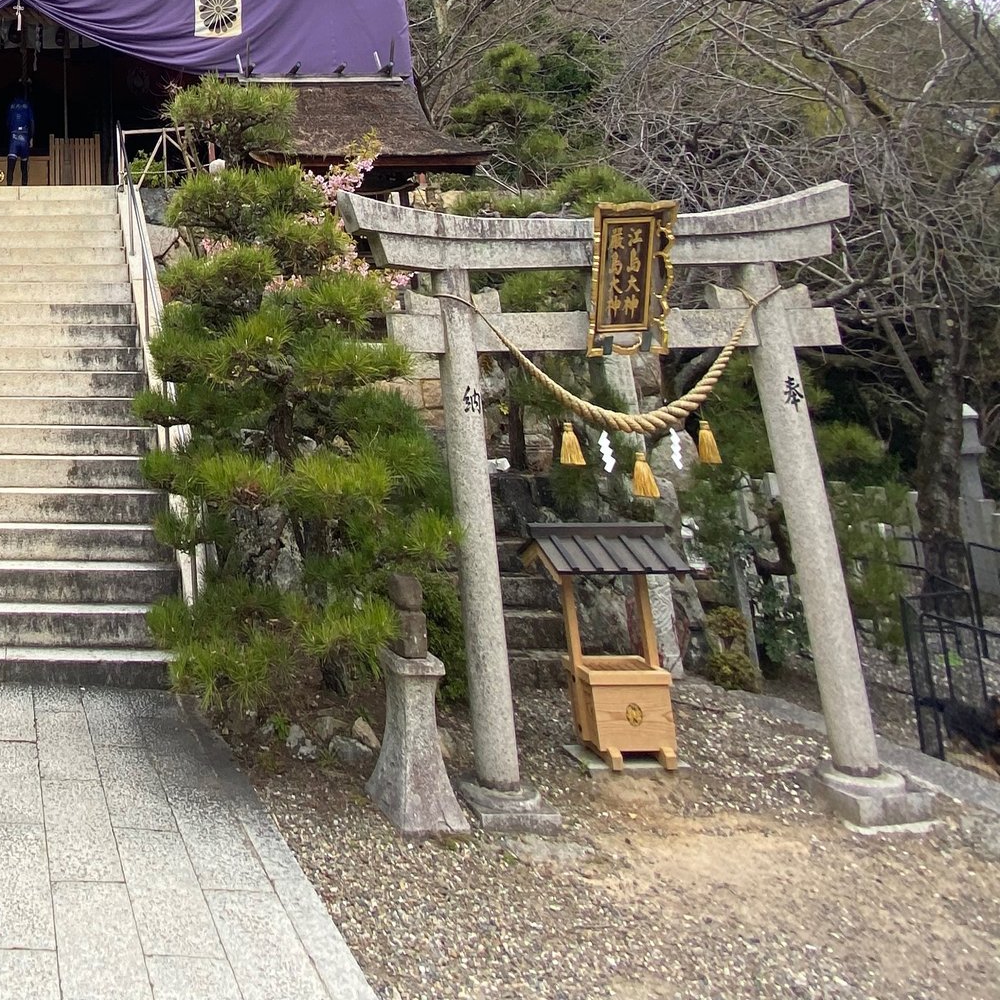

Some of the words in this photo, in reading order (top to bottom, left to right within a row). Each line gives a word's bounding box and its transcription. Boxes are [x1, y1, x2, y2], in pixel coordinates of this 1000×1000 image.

[624, 227, 643, 319] 江島大神
[463, 385, 481, 414] 納
[784, 376, 804, 413] 奉
